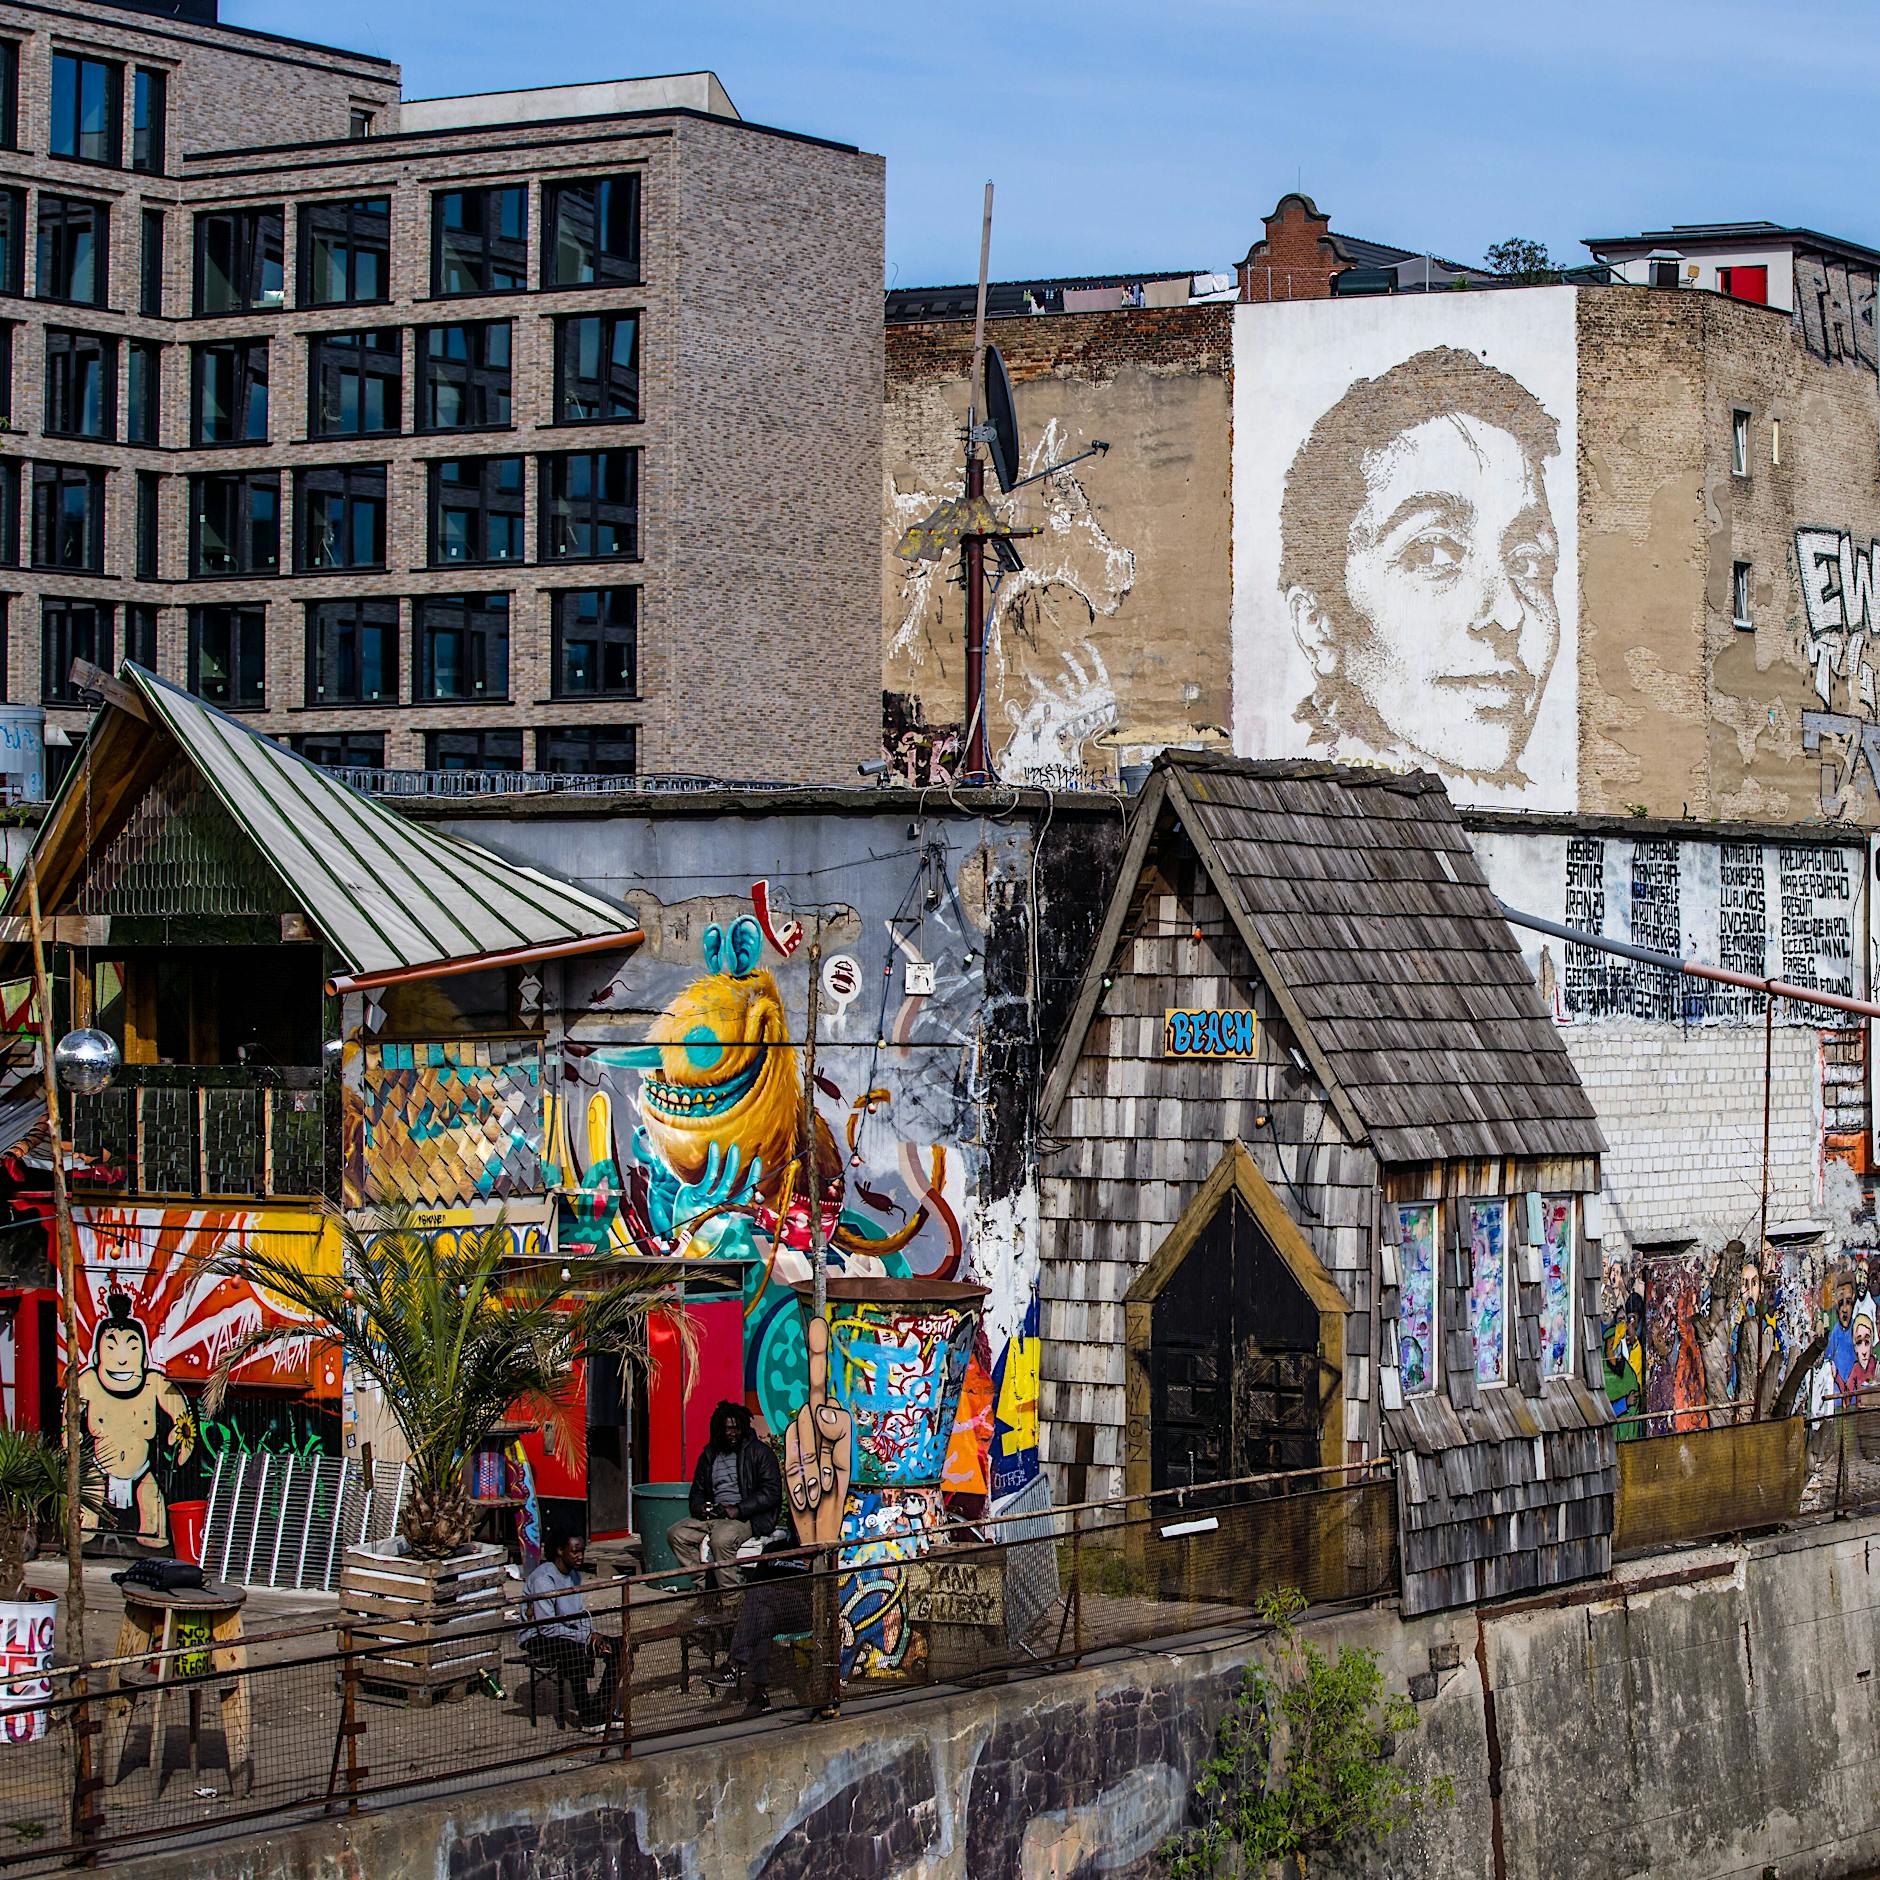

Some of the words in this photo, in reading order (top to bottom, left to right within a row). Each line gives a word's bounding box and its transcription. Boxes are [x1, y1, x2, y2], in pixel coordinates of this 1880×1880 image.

[1565, 862, 1604, 888] SAMIR
[1565, 888, 1593, 917] IRAN
[1169, 1010, 1254, 1056] BEACH
